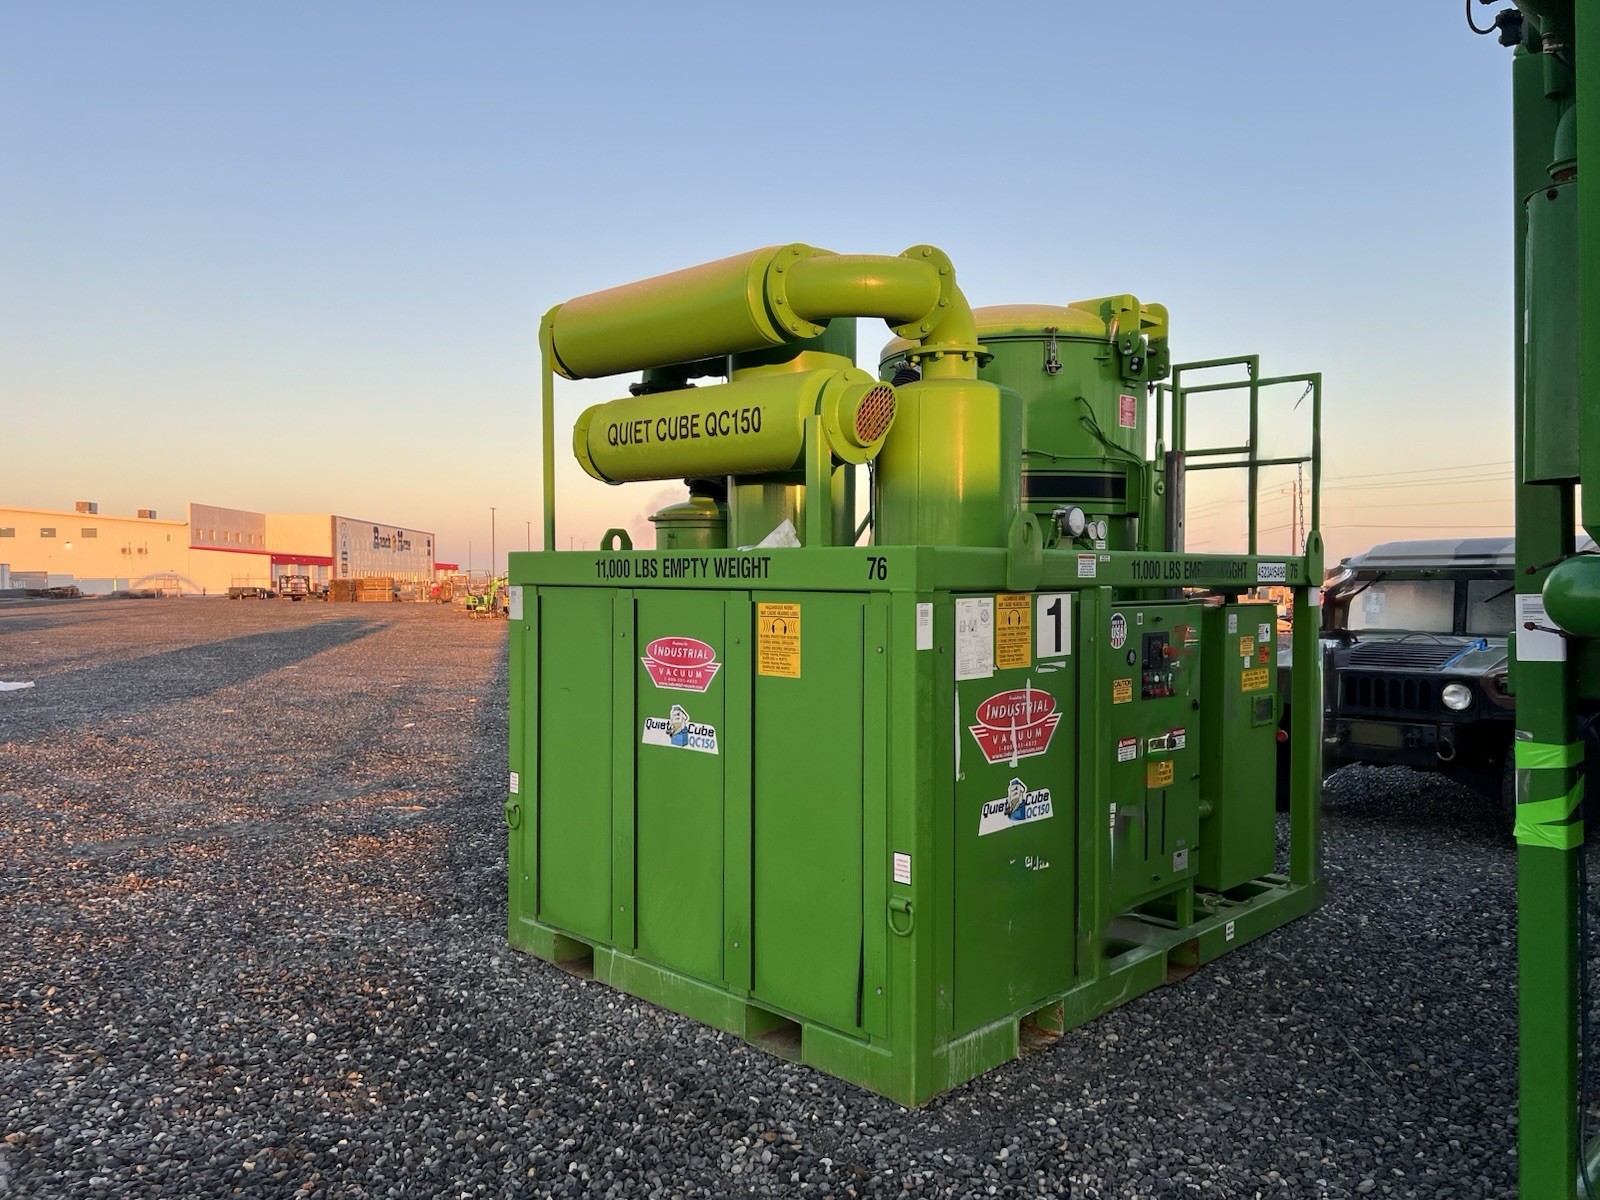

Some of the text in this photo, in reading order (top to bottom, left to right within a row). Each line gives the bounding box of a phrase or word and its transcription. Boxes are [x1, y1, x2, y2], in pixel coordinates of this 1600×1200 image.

[608, 406, 761, 446] QUIET CUBE QC150
[595, 556, 771, 581] 11,000 LBS EMPTY WEIGHT
[867, 556, 887, 580] 76
[1132, 560, 1160, 582] 11,000
[1164, 560, 1181, 579] LBS
[1290, 563, 1298, 579] 76
[1047, 598, 1061, 652] 1
[653, 644, 708, 659] INDUSTRIAL
[659, 667, 702, 678] VACUUM
[646, 718, 714, 737] Quiet Cube
[992, 728, 1042, 745] VAUUM
[689, 736, 715, 750] QC150
[983, 791, 1049, 818] Quiet Cube
[1026, 803, 1050, 819] QC150
